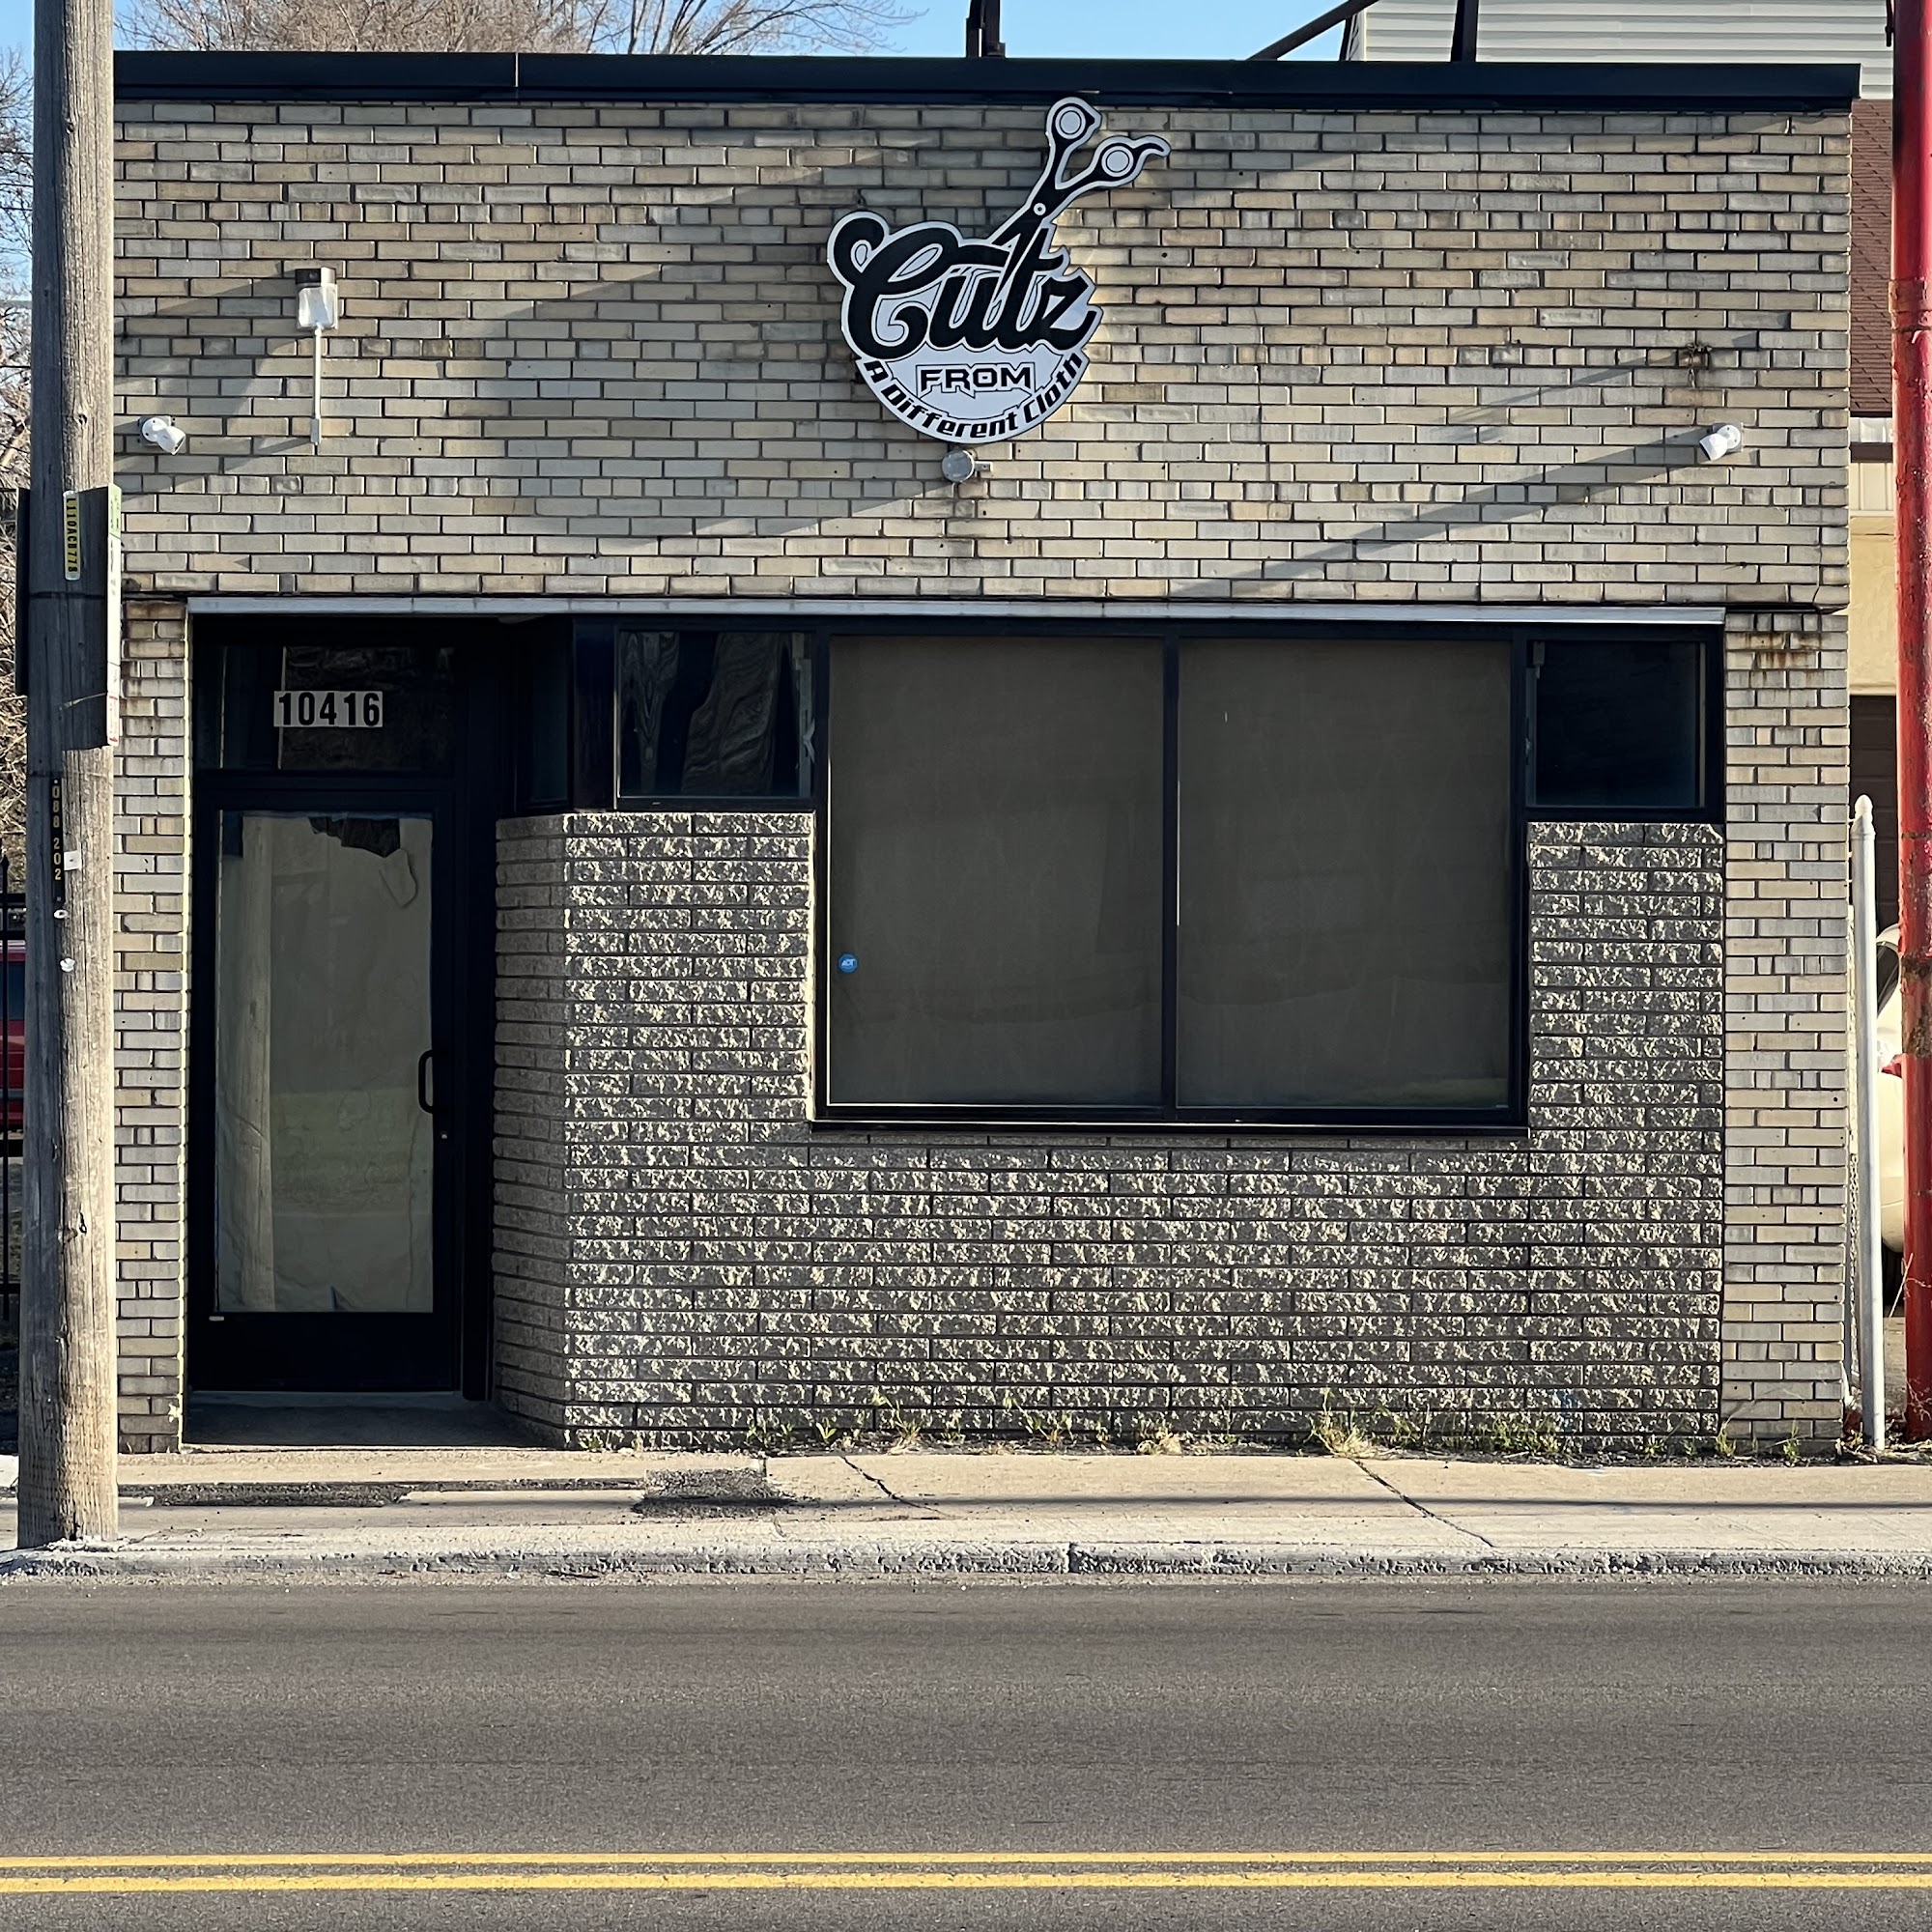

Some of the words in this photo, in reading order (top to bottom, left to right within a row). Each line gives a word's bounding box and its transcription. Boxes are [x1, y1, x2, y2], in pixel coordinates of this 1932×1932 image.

[834, 216, 1096, 359] Cutz
[863, 359, 890, 384] A
[880, 384, 1019, 439] Different
[1023, 352, 1084, 424] Cloth
[920, 367, 1031, 391] FROM
[278, 692, 380, 726] 10416
[53, 837, 62, 881] 202
